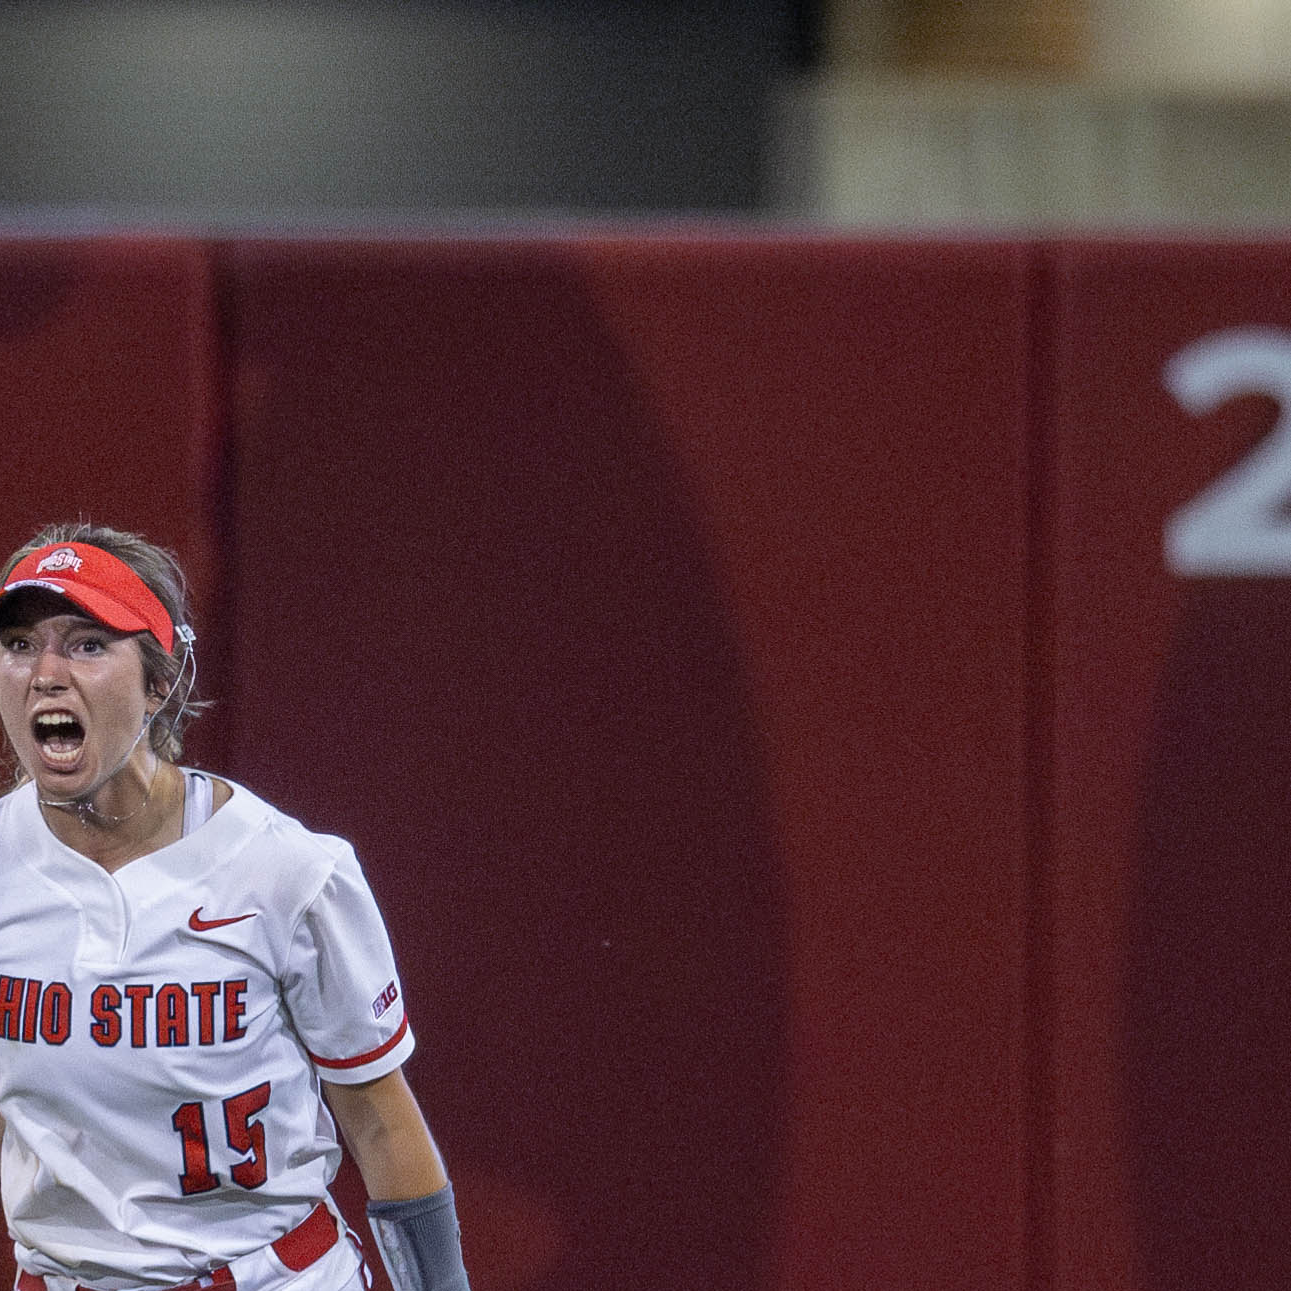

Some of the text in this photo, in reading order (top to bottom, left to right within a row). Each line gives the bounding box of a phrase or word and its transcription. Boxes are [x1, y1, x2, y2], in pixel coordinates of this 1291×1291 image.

[1163, 325, 1291, 578] 2
[89, 977, 249, 1049] STATE
[172, 1080, 272, 1197] 15
